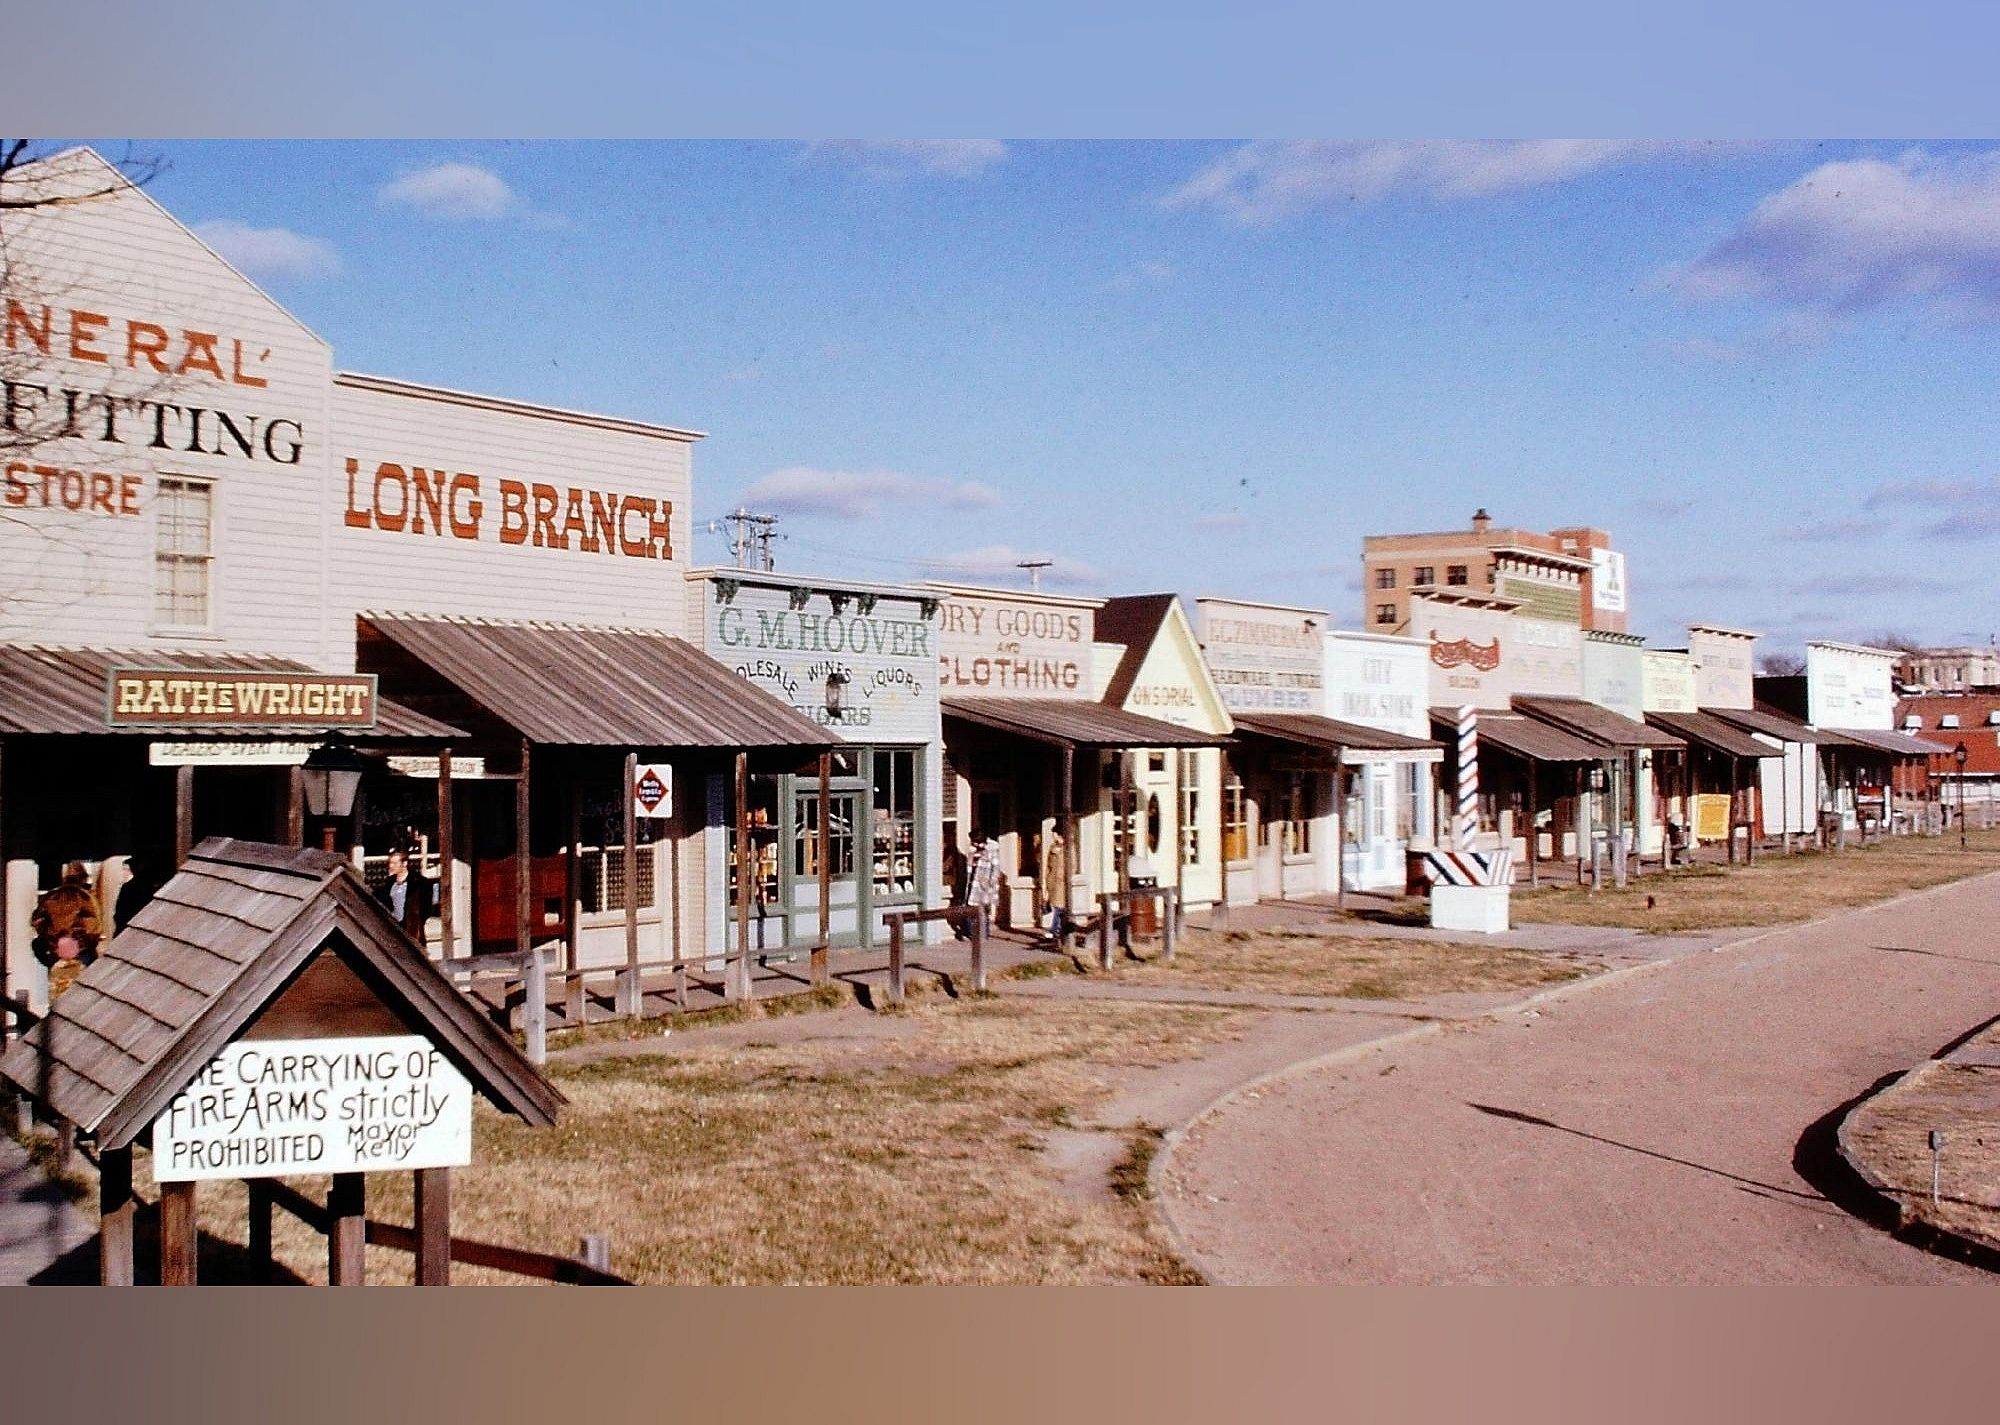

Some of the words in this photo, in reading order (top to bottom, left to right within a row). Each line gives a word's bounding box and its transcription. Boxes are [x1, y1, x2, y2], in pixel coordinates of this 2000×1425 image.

[5, 462, 143, 515] STORE
[344, 457, 482, 540] LONG
[499, 478, 673, 560] BRANCH
[796, 613, 930, 657] HOOVER
[997, 609, 1080, 642] GOODS
[117, 680, 217, 714] RATH
[234, 682, 368, 716] WRIGHT
[862, 668, 922, 698] LIQUORS
[238, 1051, 399, 1087] CARRYING
[407, 1051, 440, 1078] OF
[339, 1084, 450, 1127] strictly
[173, 1134, 324, 1169] PROHIBITED
